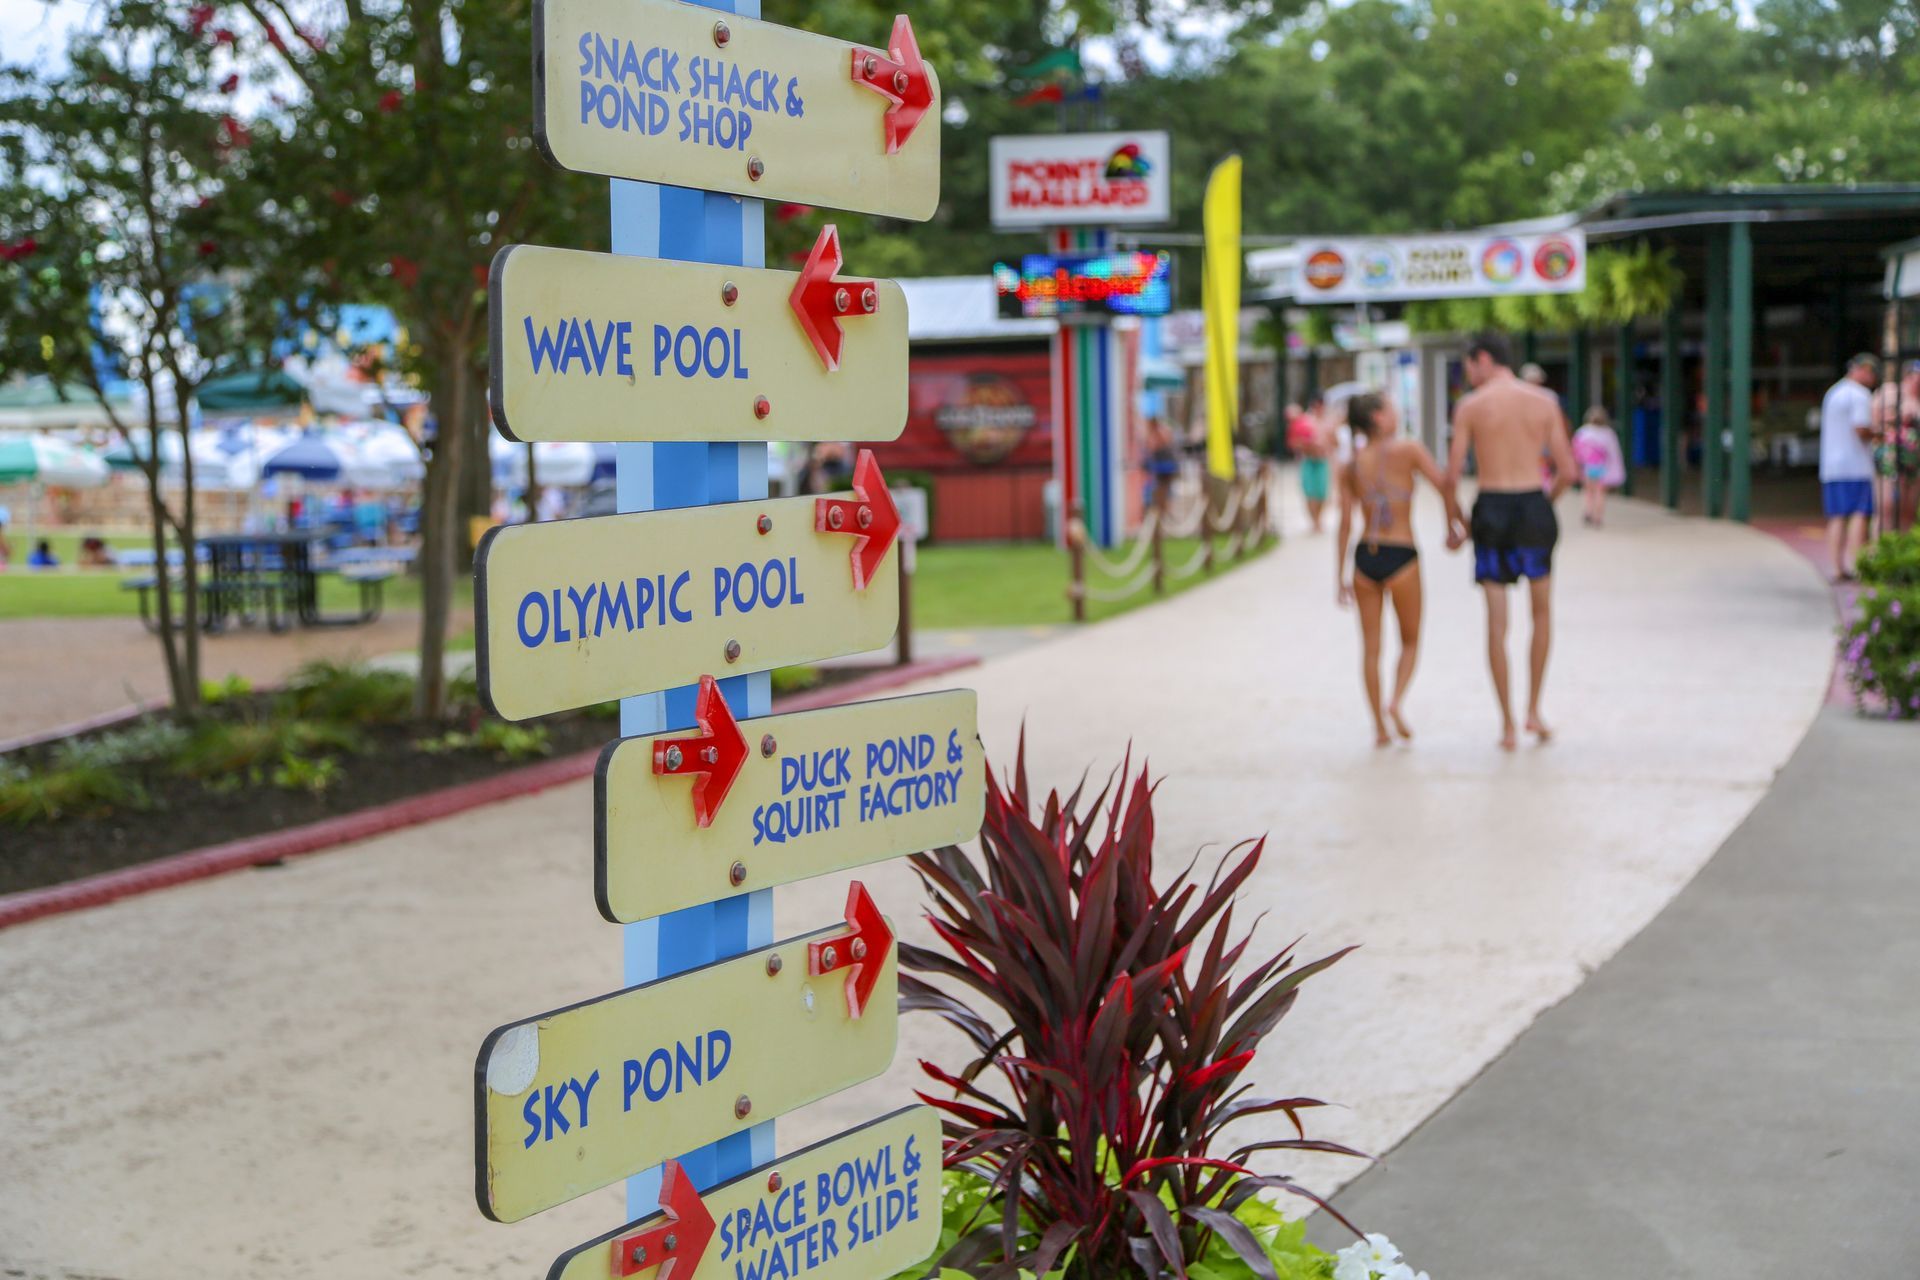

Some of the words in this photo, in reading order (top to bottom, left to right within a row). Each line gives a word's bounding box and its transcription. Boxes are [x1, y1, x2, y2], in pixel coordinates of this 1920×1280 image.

[579, 32, 681, 93] SNACK
[689, 56, 780, 113] SHACK
[785, 76, 805, 118] &
[580, 80, 670, 136] POND
[679, 100, 753, 151] SHOP
[523, 315, 633, 376] WAVE
[654, 324, 749, 379] POOL
[517, 570, 693, 648] OLYMPIC
[714, 557, 805, 617] POOL
[781, 747, 852, 796] DUCK
[866, 734, 936, 780] POND
[946, 728, 964, 764] &
[752, 790, 846, 846] SQUIRT
[860, 768, 964, 822] FACTORY
[523, 1069, 600, 1150] SKY
[623, 1029, 732, 1112] POND
[720, 1180, 807, 1261] SPACE
[817, 1145, 897, 1217] BOWL
[903, 1134, 922, 1177] &
[735, 1219, 839, 1280] WATER
[848, 1179, 919, 1250] SLIDE
